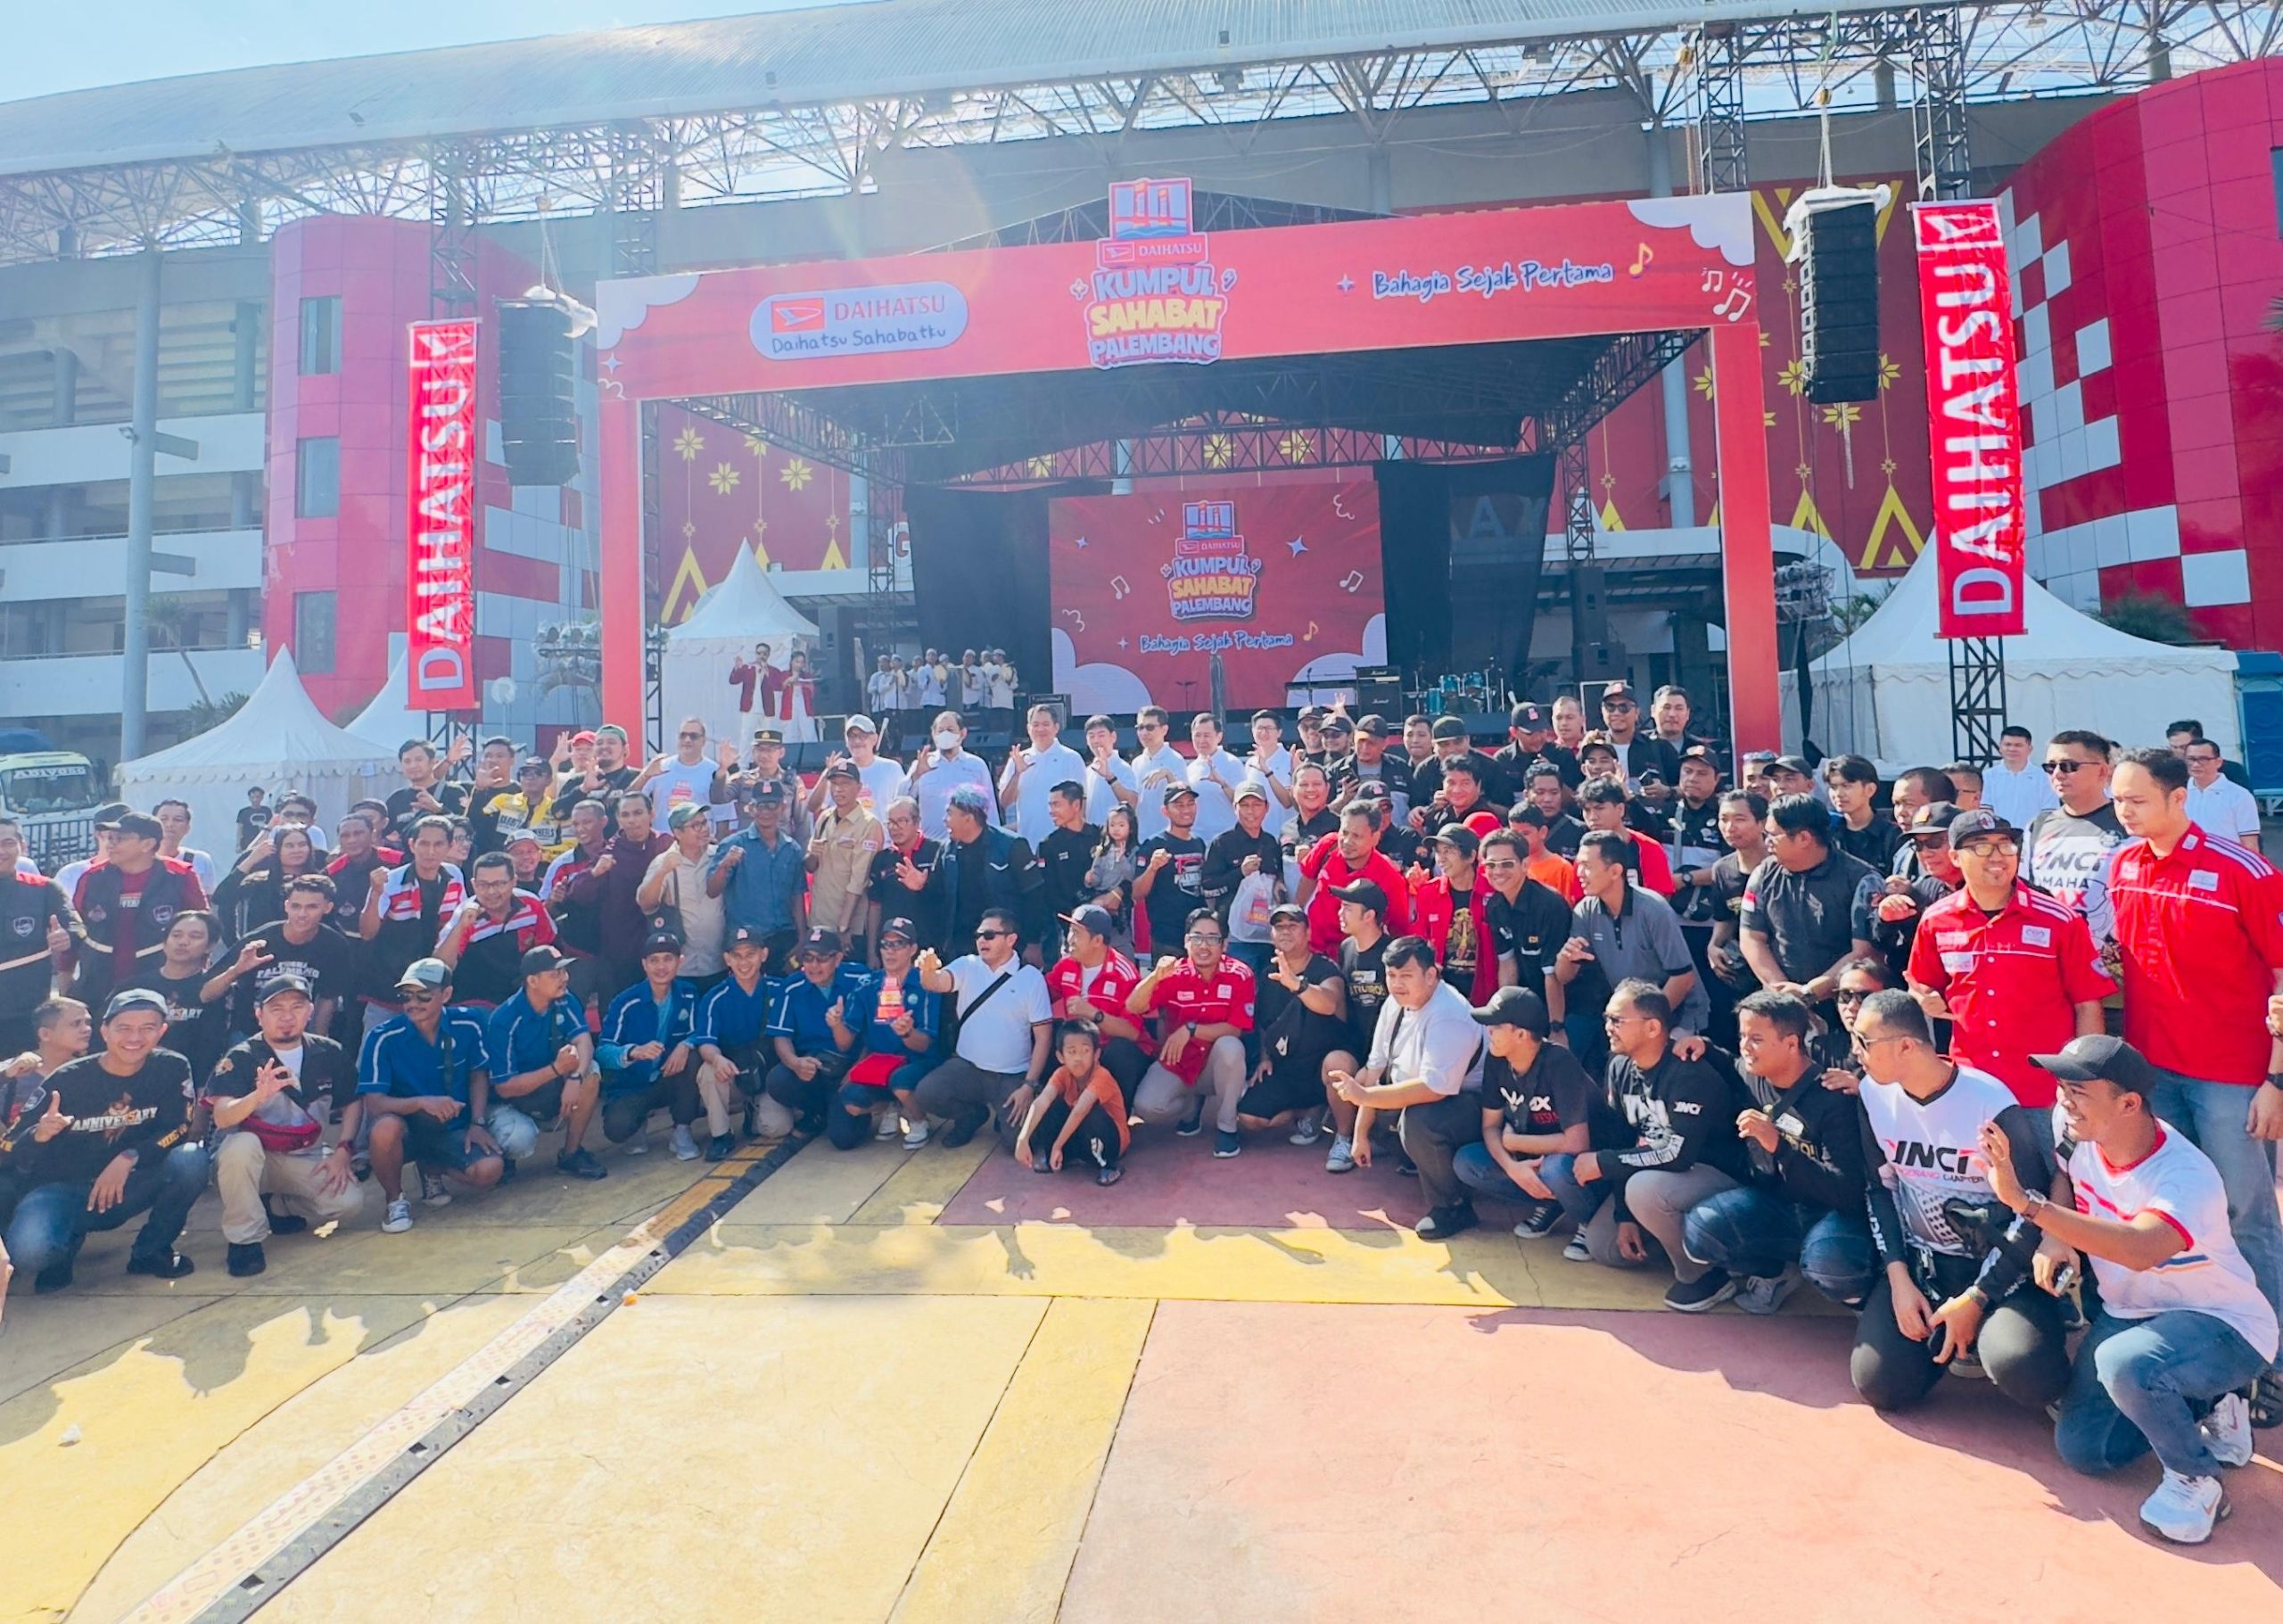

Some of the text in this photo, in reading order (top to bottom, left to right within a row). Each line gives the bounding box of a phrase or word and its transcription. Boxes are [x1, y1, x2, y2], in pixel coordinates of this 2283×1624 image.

[1138, 243, 1202, 257] DAIHATSU
[1095, 268, 1215, 301] KUMPUL
[1374, 261, 1612, 300] Bahagia Sejak Pertama
[834, 295, 945, 321] DAIHATSU
[1090, 298, 1223, 336] SAHABAT
[771, 324, 947, 354] Daihatsu Sahabatku
[1091, 333, 1221, 361] PALEMBANG
[1934, 262, 2013, 615] DAIHATSU
[417, 379, 470, 691] DAIHATSU
[1174, 556, 1248, 578] KUMPUL
[1172, 576, 1253, 599] SAHABAT
[1173, 598, 1252, 614] PALEMBANG
[1141, 630, 1293, 655] Bahagia Sejak Pertama
[71, 1106, 159, 1133] ANNIVERSARY
